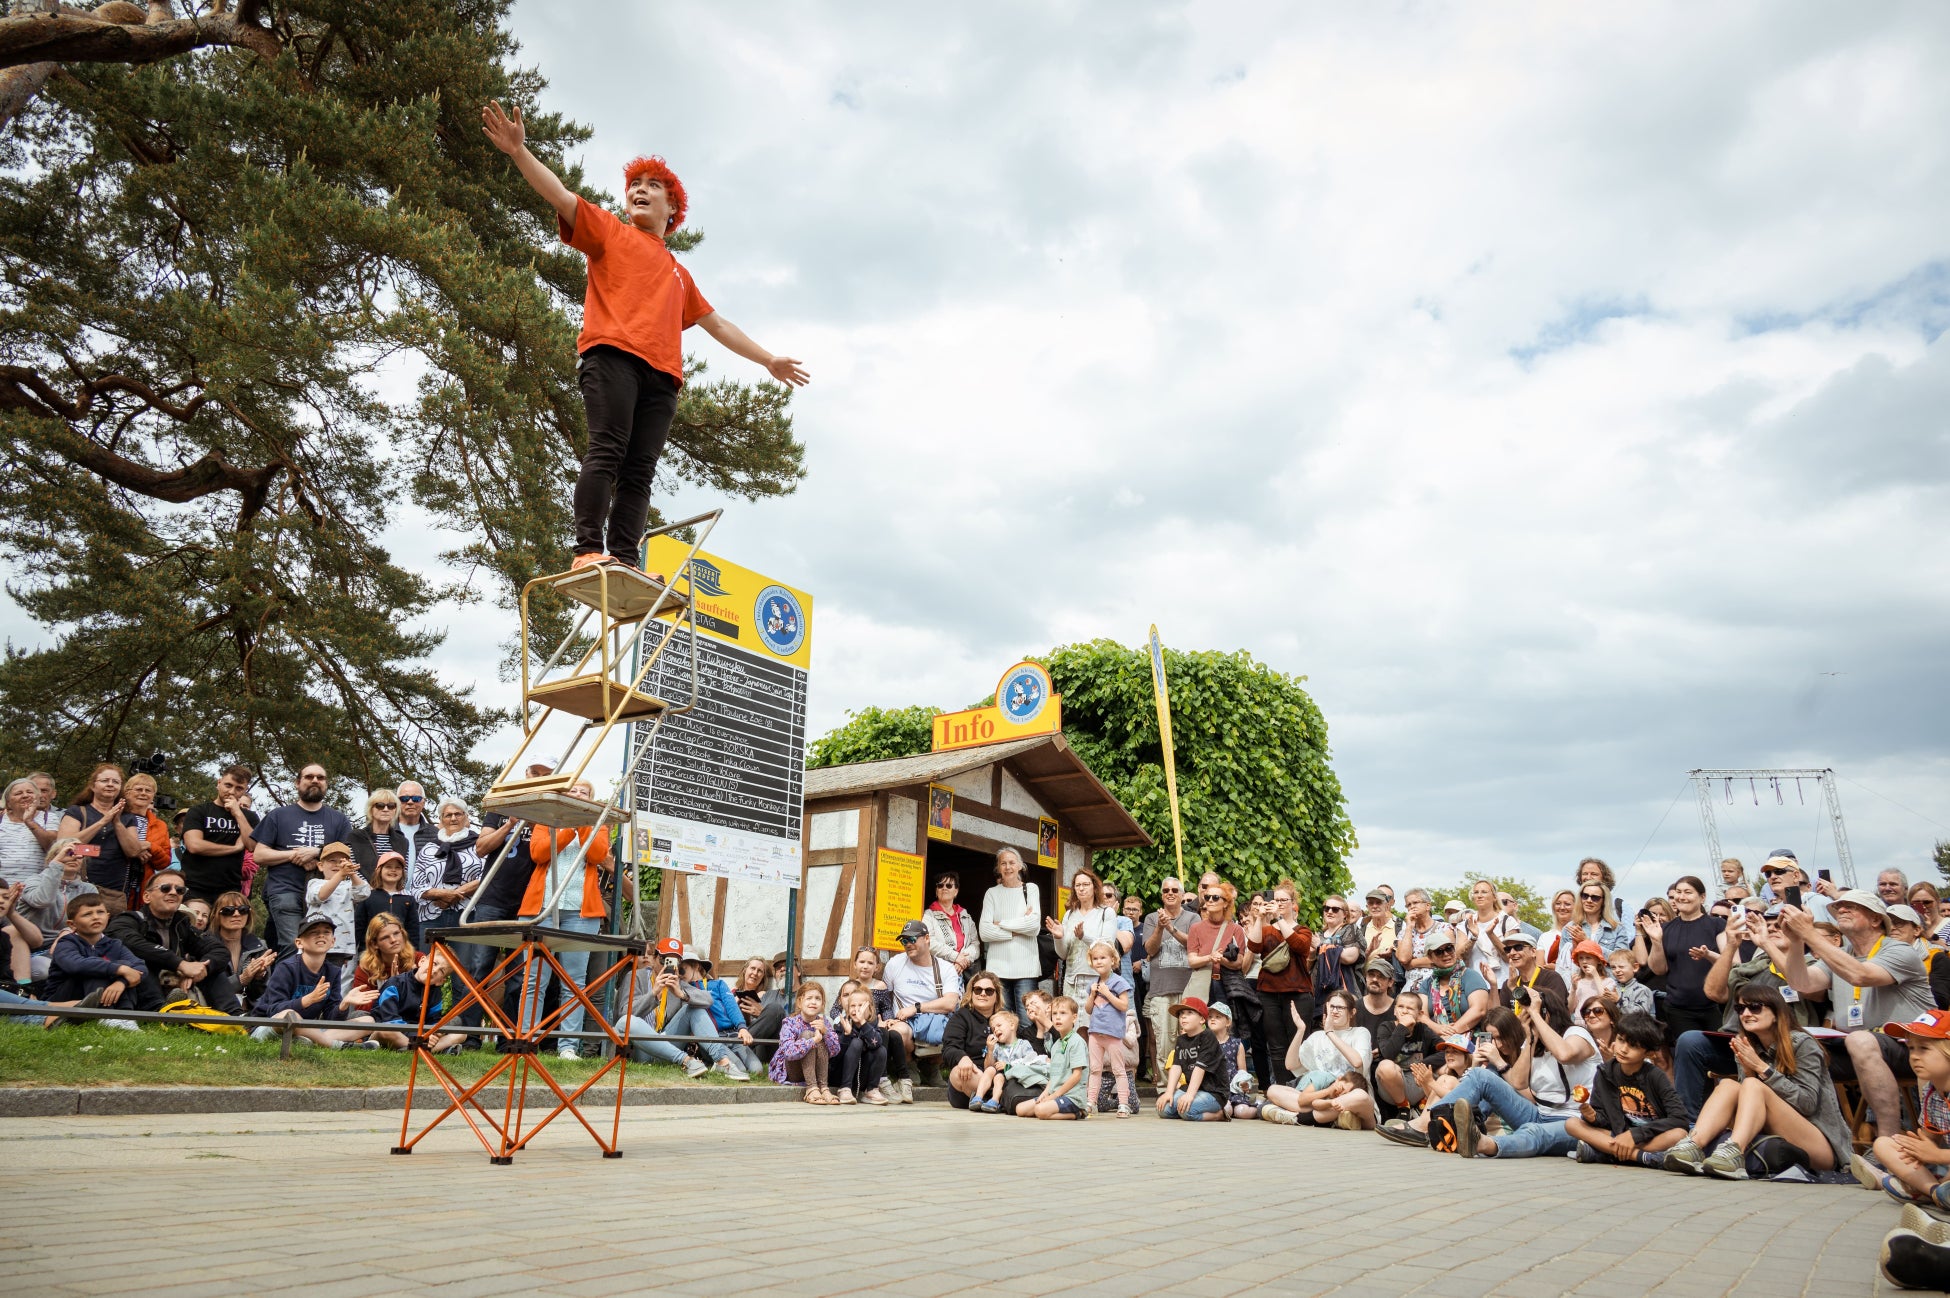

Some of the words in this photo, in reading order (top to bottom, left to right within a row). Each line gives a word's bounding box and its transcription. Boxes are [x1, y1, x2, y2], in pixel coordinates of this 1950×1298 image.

[696, 599, 739, 622] sauftritte
[648, 621, 659, 630] Zeit
[656, 724, 677, 739] Clap
[679, 731, 696, 743] Clap
[942, 714, 994, 745] Info
[793, 749, 798, 758] 2
[654, 750, 682, 766] Payaso
[792, 783, 798, 792] 4
[686, 784, 699, 794] und
[652, 789, 713, 810] Druckerkolonne
[790, 818, 796, 827] 1
[206, 816, 240, 830] POL
